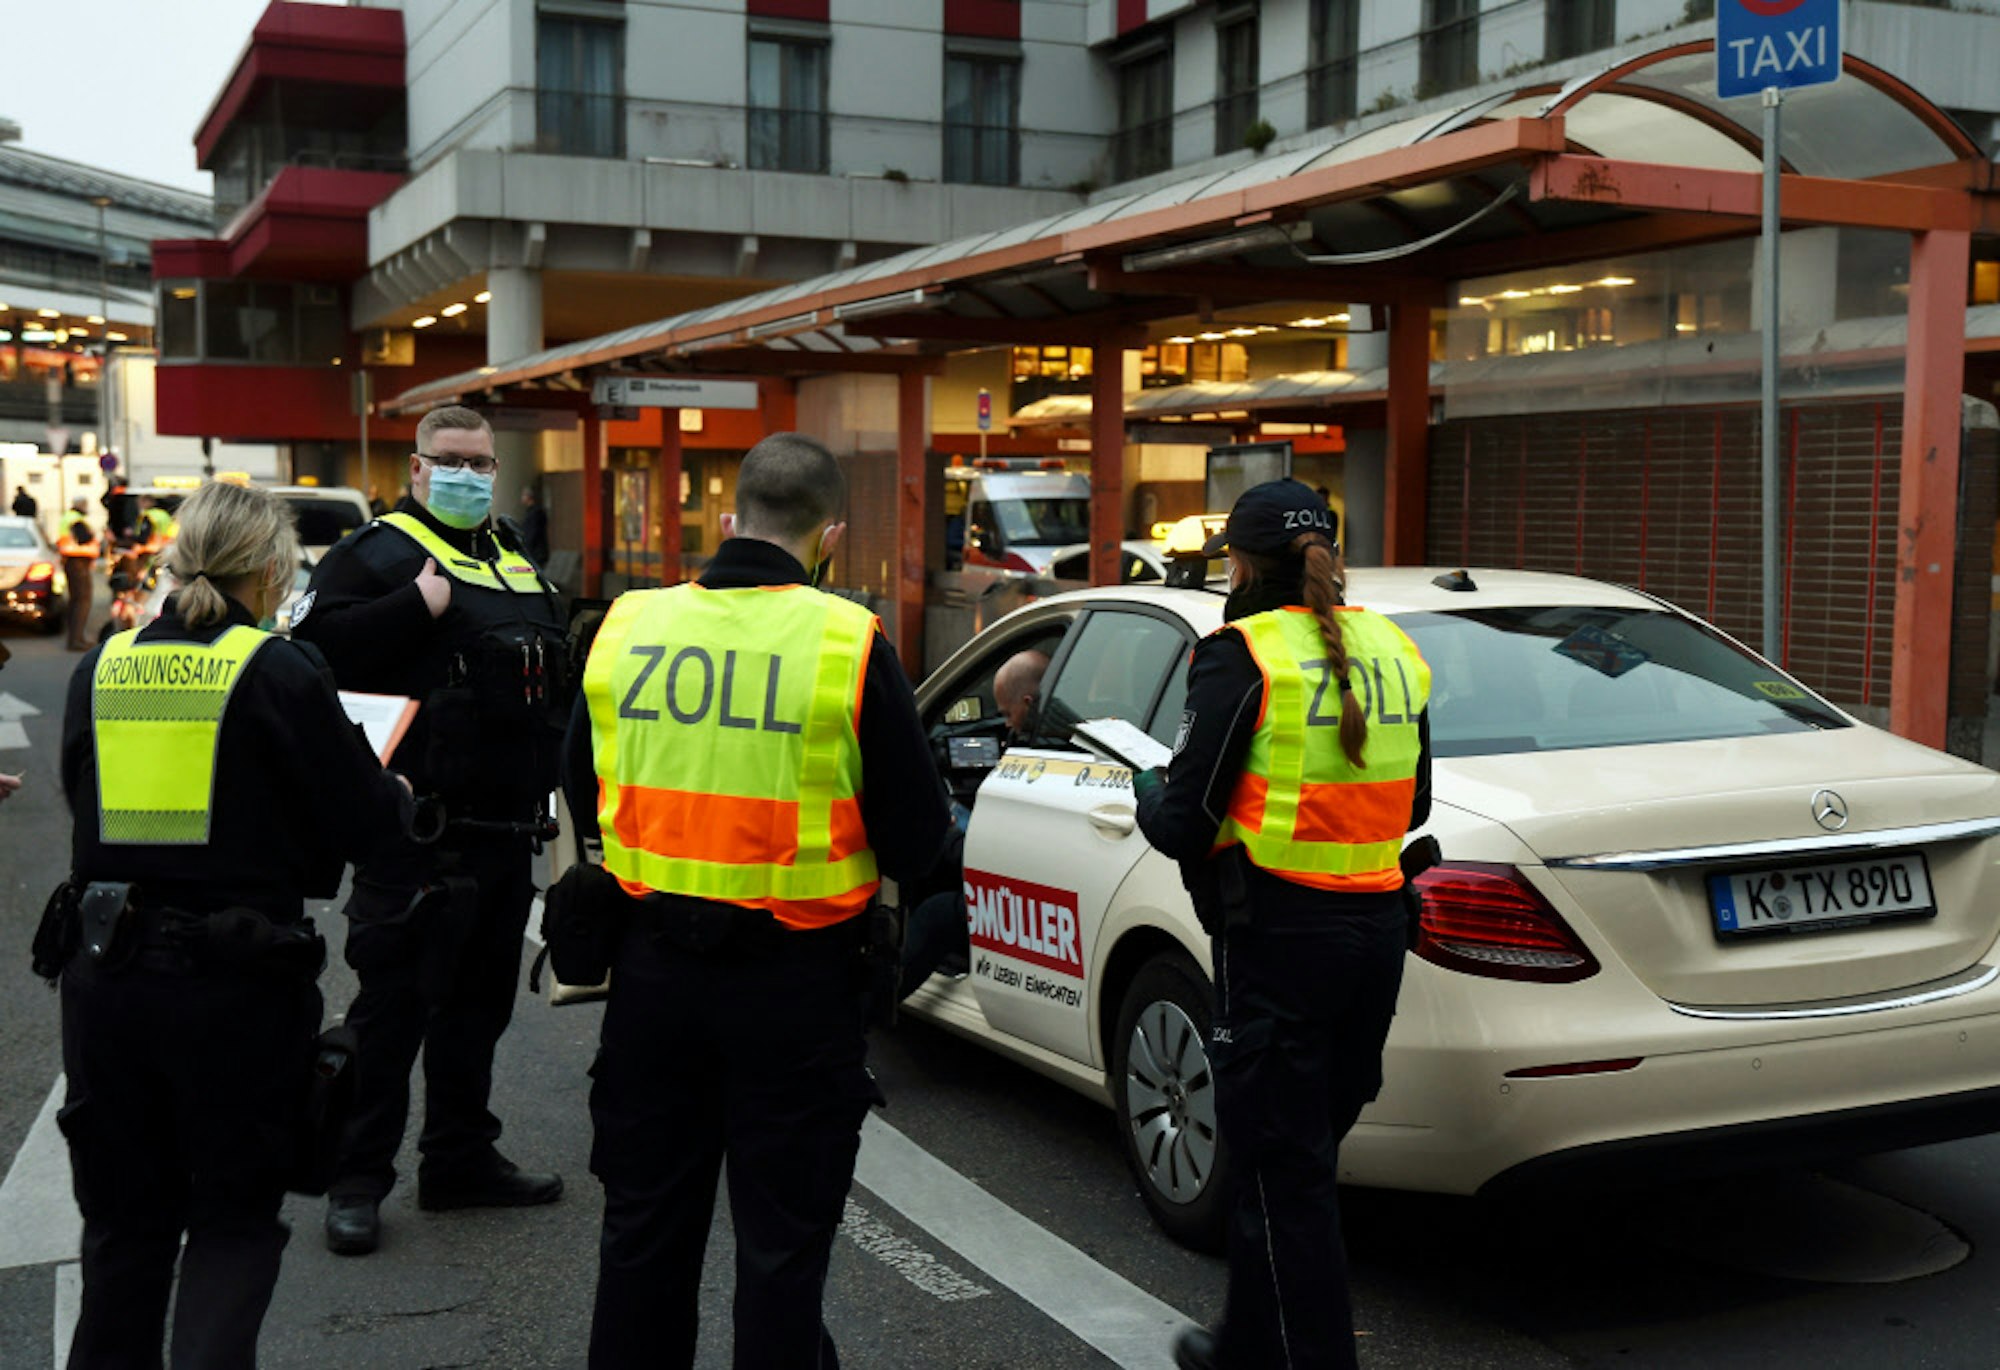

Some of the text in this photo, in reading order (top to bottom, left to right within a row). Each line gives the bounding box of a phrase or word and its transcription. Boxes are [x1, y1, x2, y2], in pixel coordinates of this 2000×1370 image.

[1728, 25, 1826, 79] TAXI
[1283, 509, 1332, 529] ZOLL
[97, 654, 236, 685] ORDNUNGSAMT
[619, 645, 802, 734] ZOLL
[1746, 863, 1912, 921] K TX 890
[993, 964, 1023, 988] LEBEN
